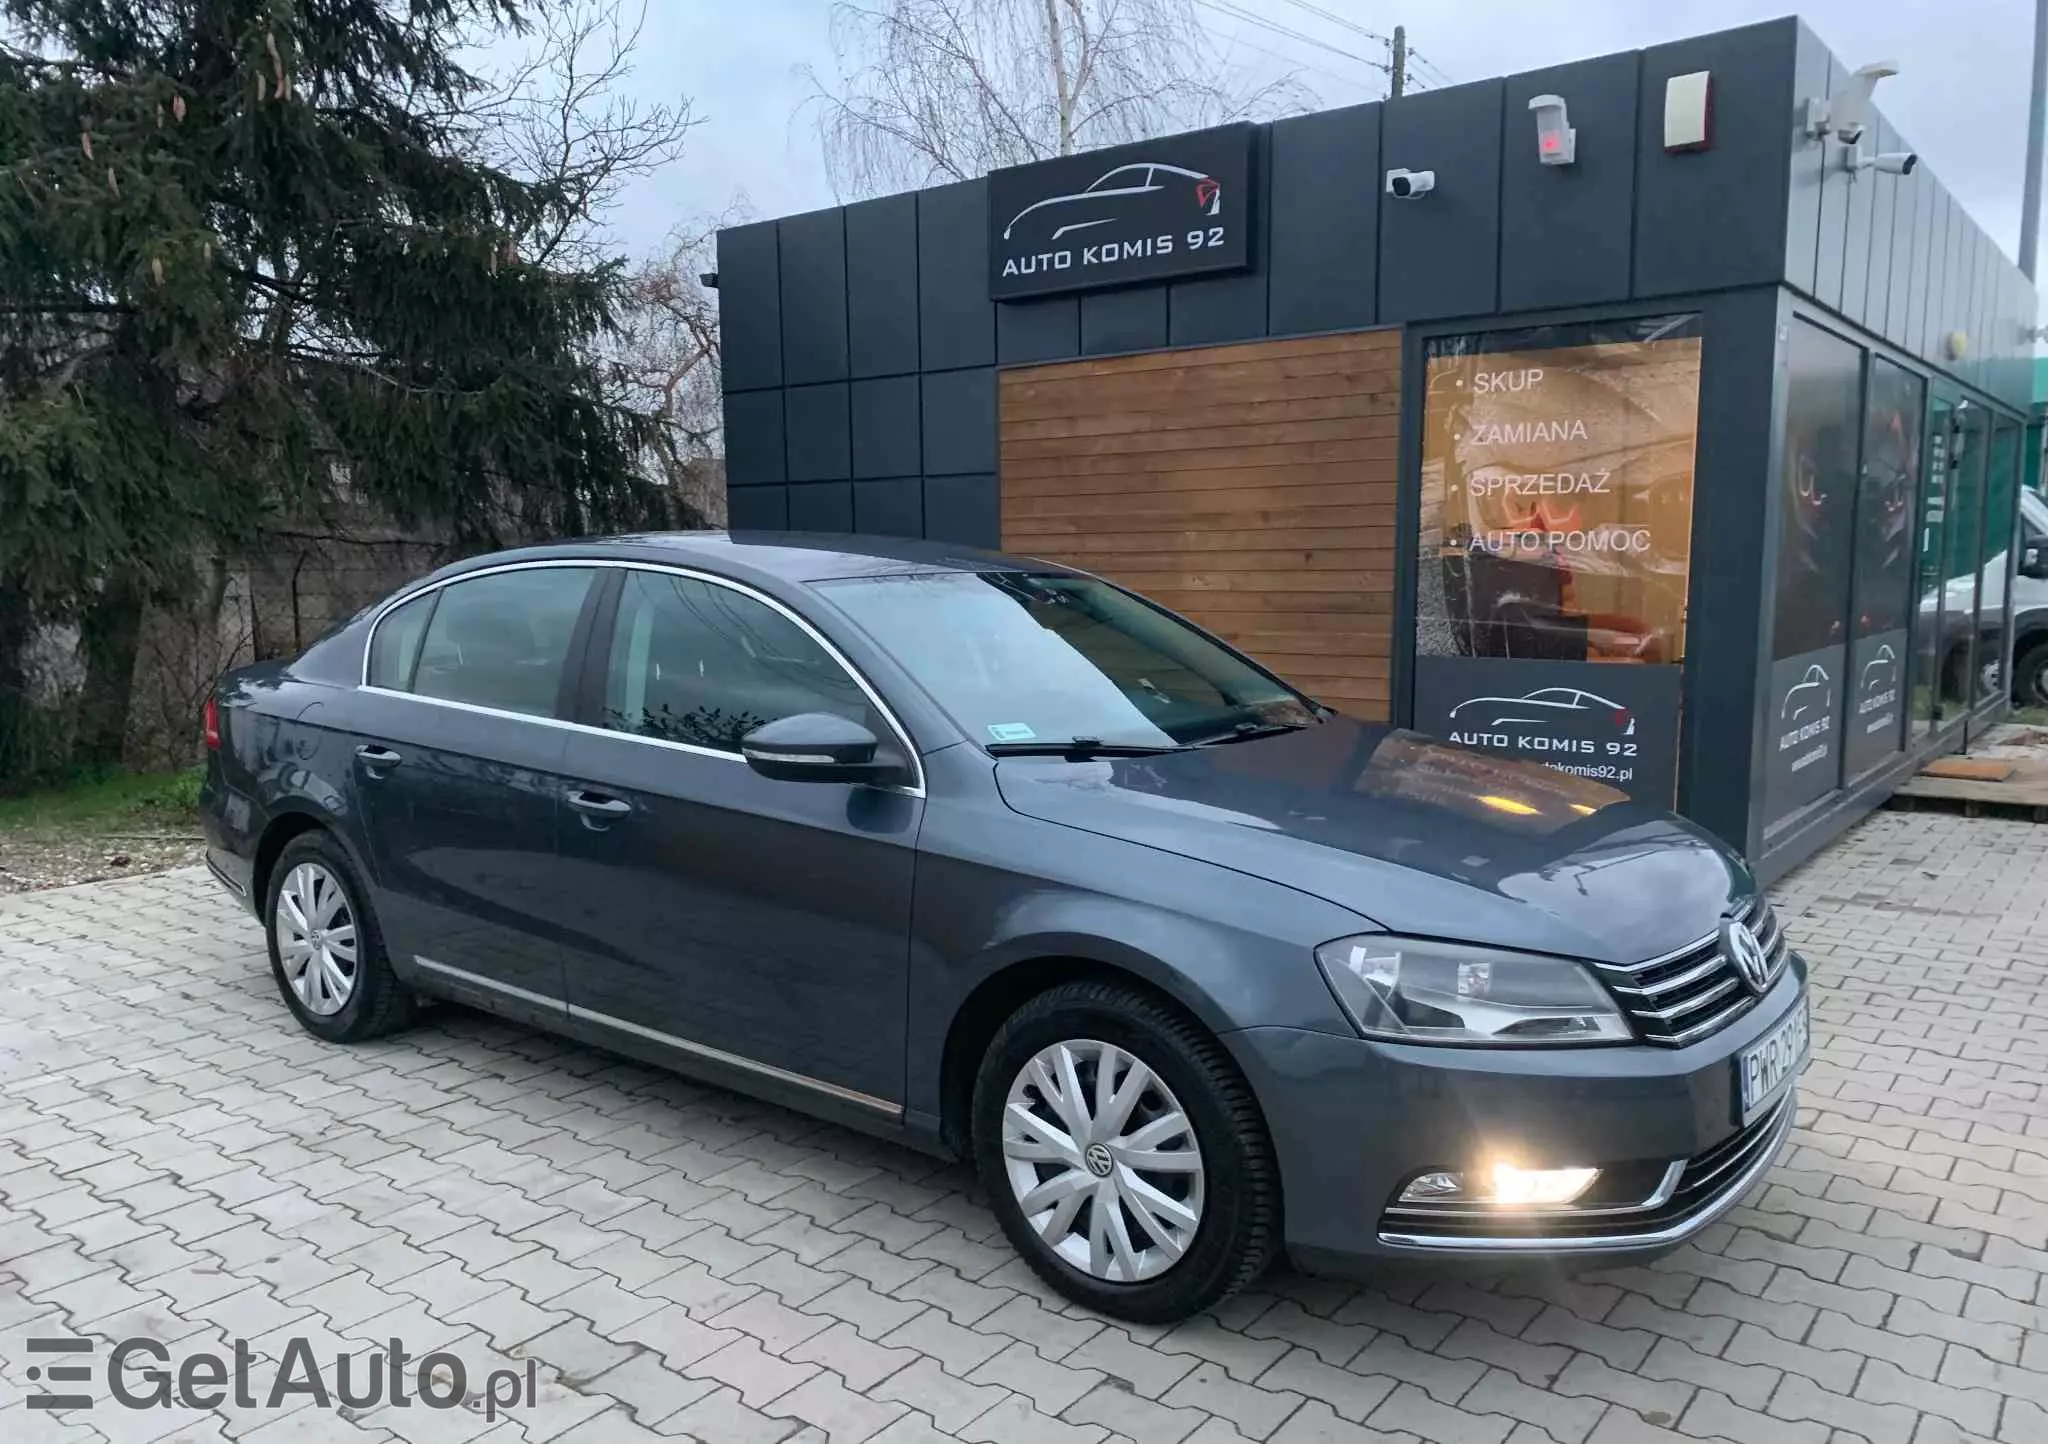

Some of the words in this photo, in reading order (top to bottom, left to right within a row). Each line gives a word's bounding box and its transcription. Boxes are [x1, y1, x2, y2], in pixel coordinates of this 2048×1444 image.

[1002, 251, 1071, 277] AUTO
[1083, 235, 1173, 264] KOMIS
[1187, 226, 1225, 250] 92
[1473, 369, 1544, 394] SKUP
[1471, 419, 1588, 446] ZAMIANA
[1468, 531, 1540, 552] AUTO
[1549, 530, 1651, 552] POMOC
[1449, 731, 1508, 747] AUTO
[1518, 736, 1595, 753] KOMIS
[1606, 743, 1638, 757] 92
